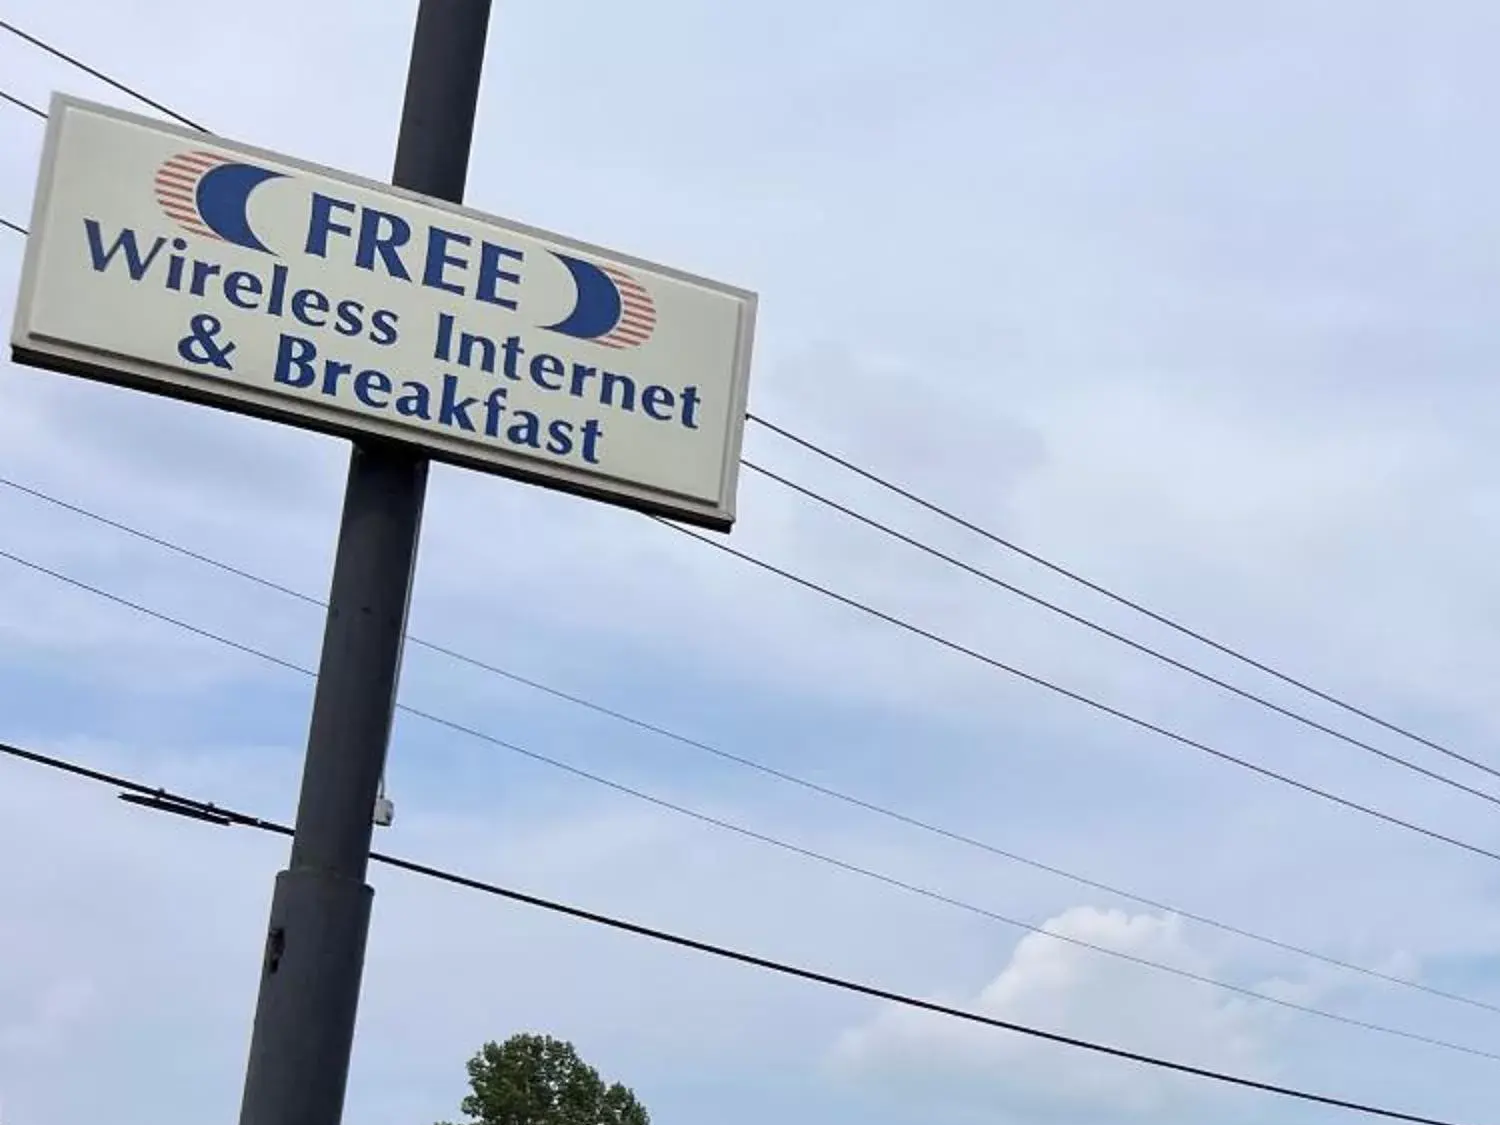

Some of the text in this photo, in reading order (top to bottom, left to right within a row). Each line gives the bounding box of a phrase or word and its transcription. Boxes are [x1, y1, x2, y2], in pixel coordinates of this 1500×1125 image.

[83, 217, 700, 430] Wireless Internet
[304, 191, 525, 311] FREE
[177, 312, 603, 465] & Breakfast
